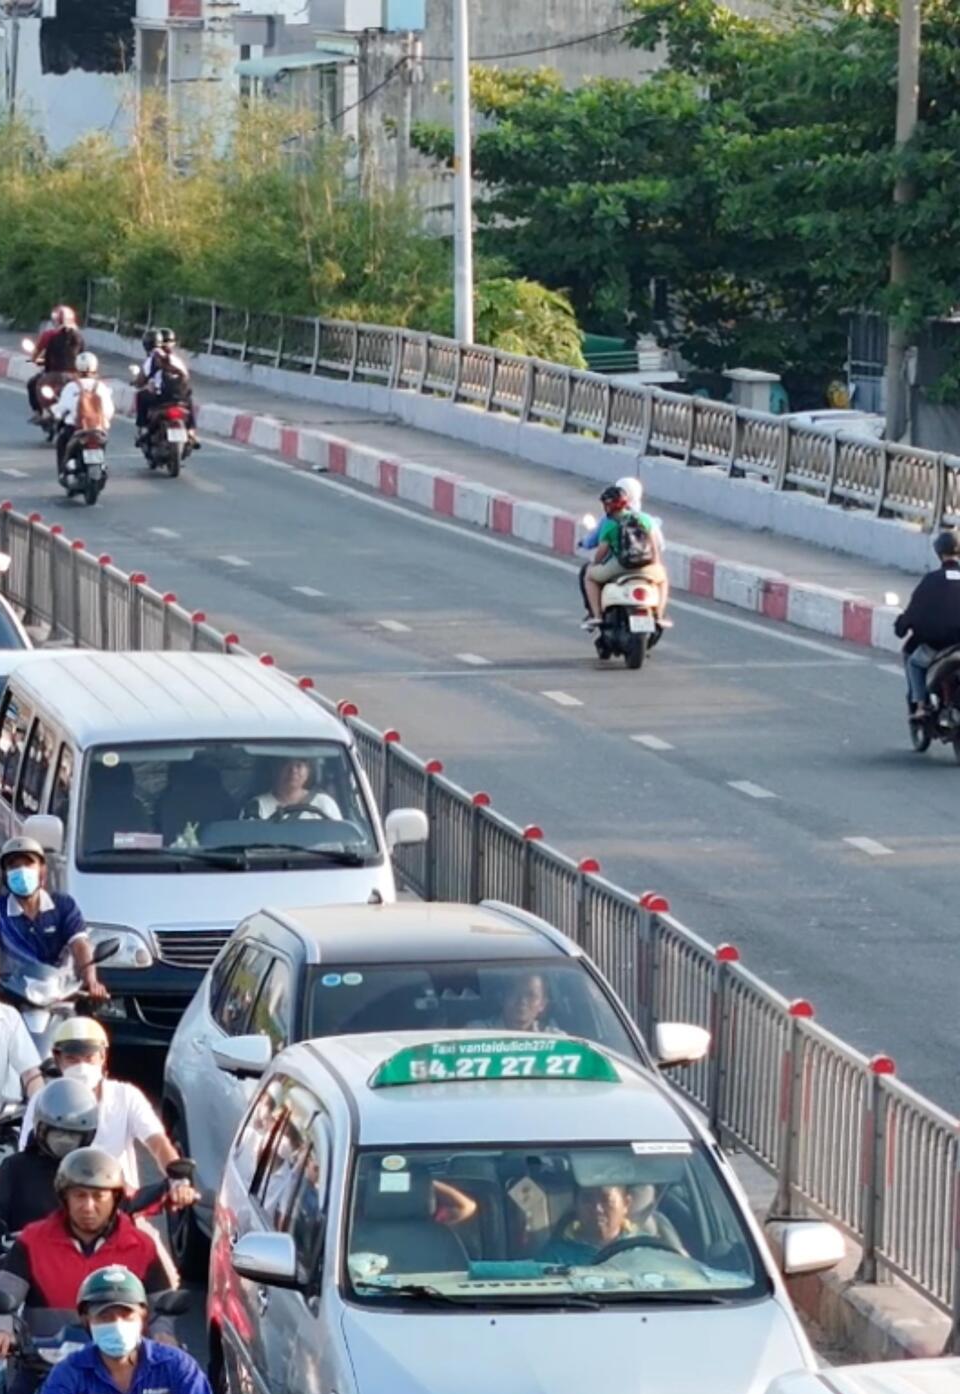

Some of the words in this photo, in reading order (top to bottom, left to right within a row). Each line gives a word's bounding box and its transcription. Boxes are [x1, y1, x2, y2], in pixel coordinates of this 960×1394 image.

[432, 1044, 456, 1055] Taxi
[500, 1056, 537, 1076] 27
[545, 1054, 582, 1075] 27
